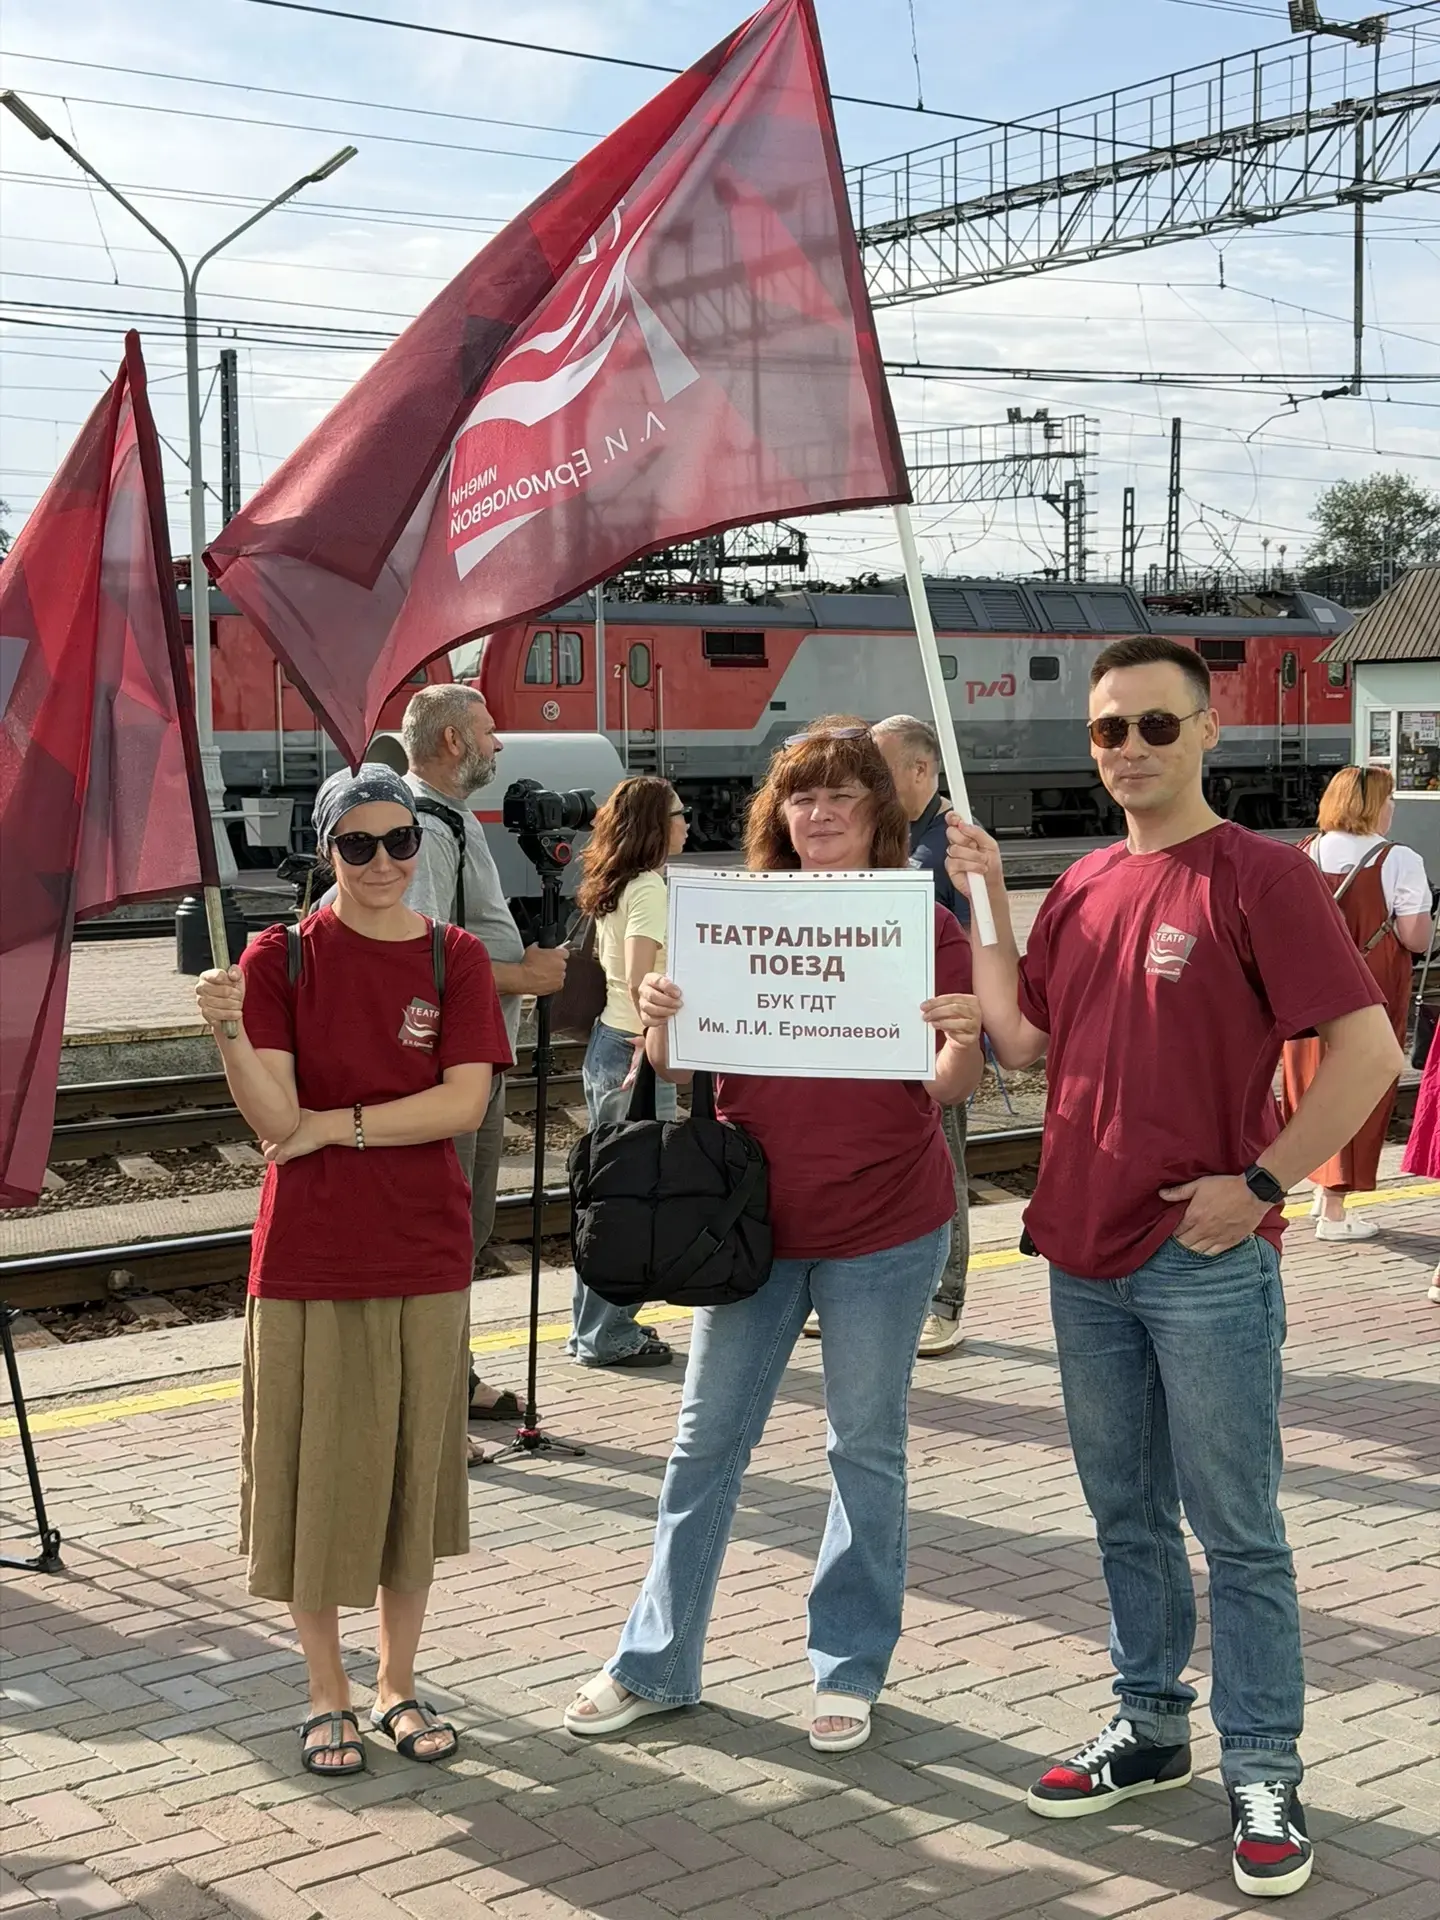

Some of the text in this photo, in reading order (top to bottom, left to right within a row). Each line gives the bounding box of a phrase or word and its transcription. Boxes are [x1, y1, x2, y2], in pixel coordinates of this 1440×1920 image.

[613, 664, 621, 678] 2
[696, 920, 902, 948] ТЕАТРАЛЬНЫЙ
[1156, 932, 1186, 943] ТЕАТР
[750, 954, 845, 982] ПОЕЗД
[410, 1006, 440, 1019] ТЕАТР
[757, 993, 836, 1013] БУК ГДТ
[698, 1017, 900, 1040] Им. Л.И. Ермолаевой
